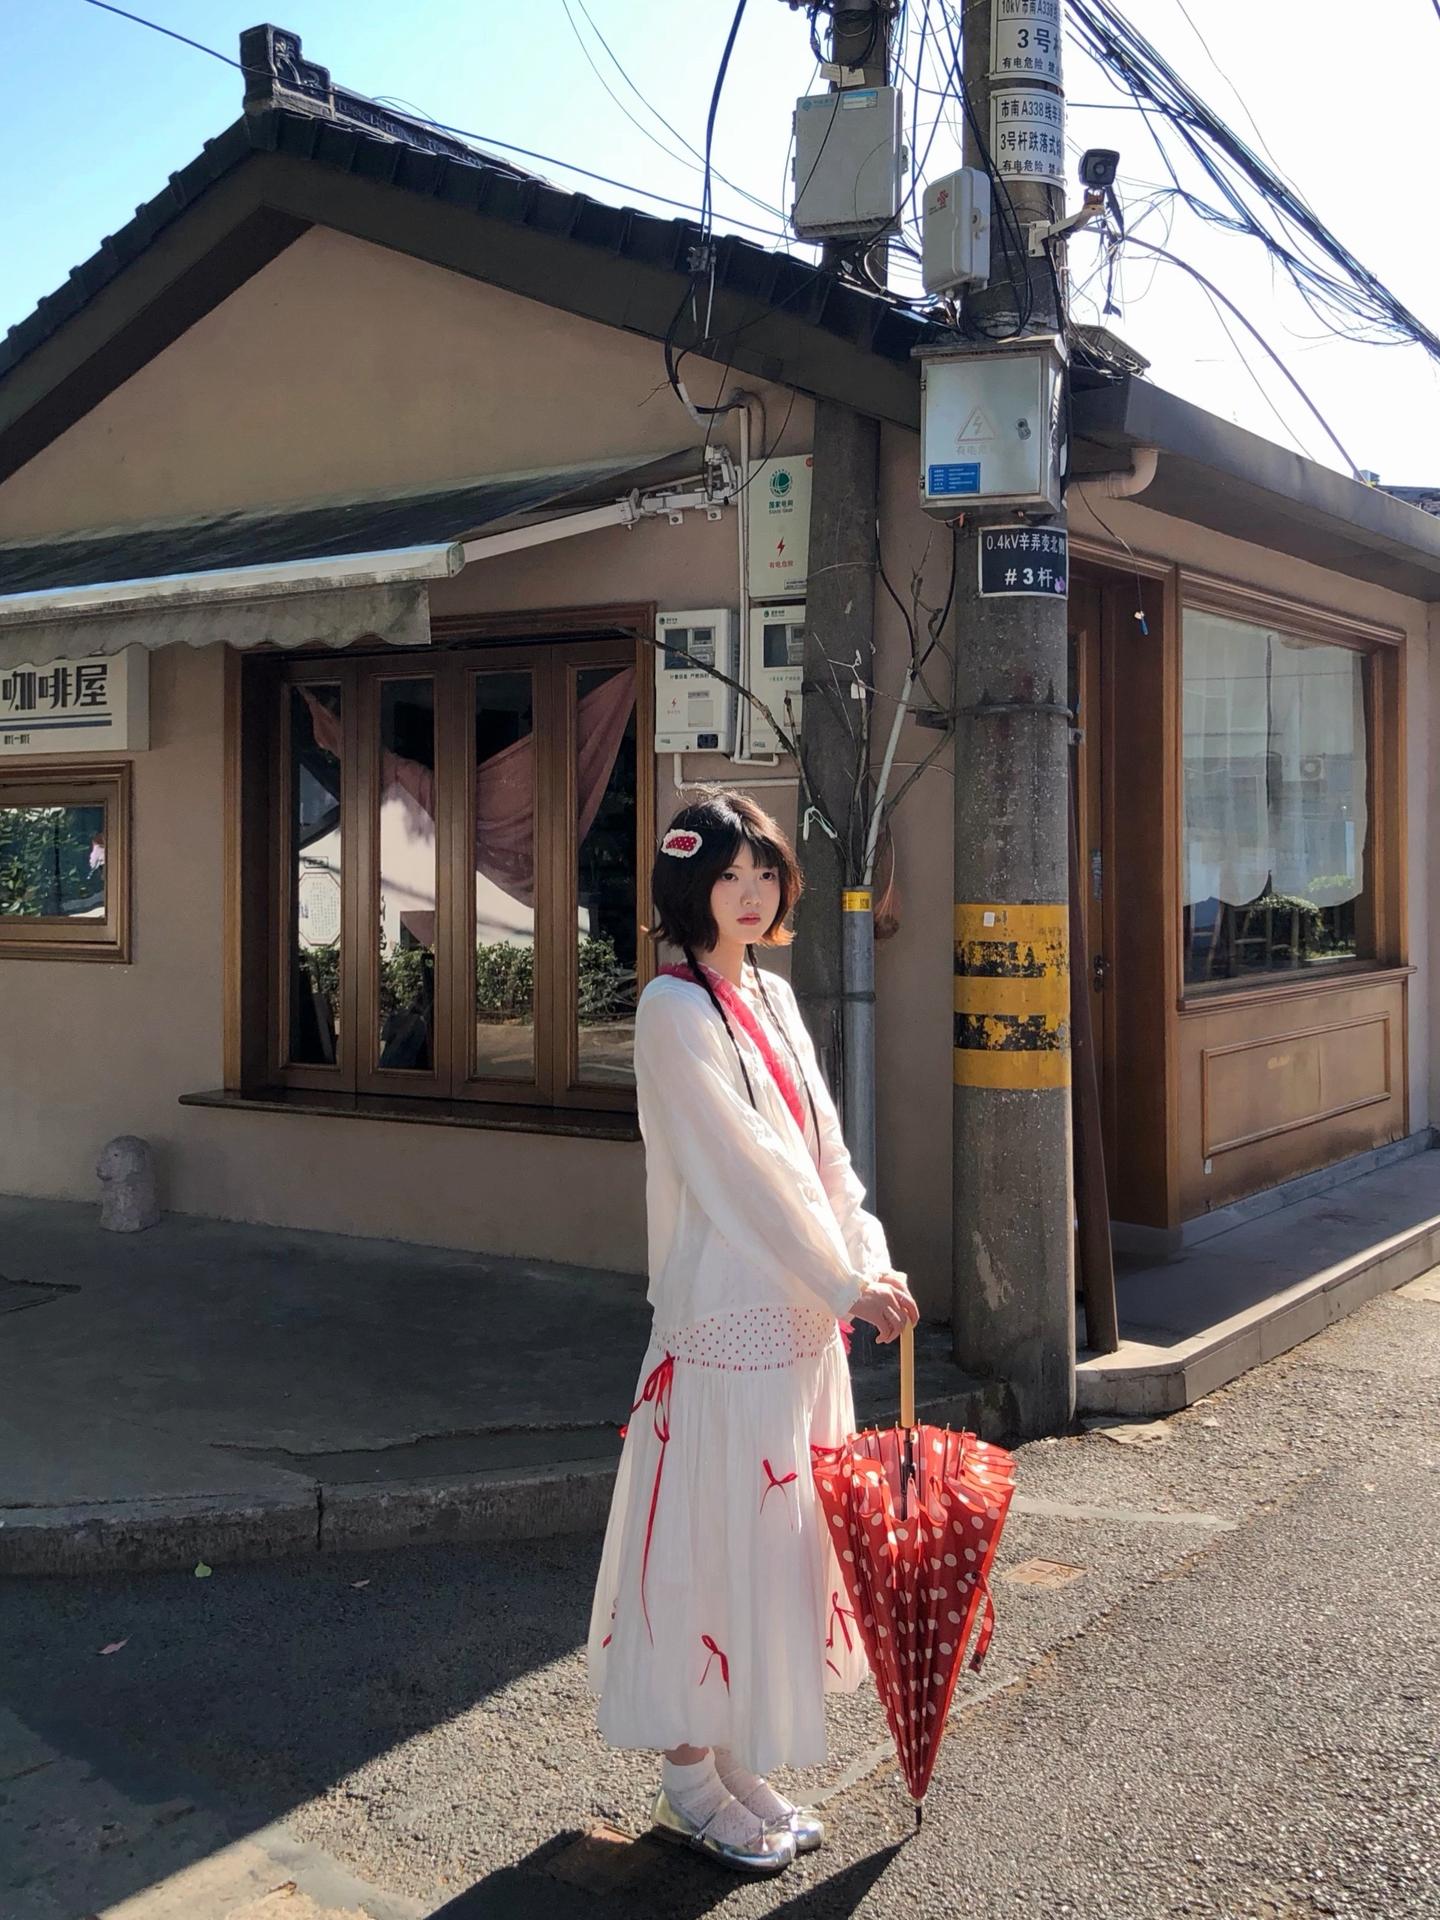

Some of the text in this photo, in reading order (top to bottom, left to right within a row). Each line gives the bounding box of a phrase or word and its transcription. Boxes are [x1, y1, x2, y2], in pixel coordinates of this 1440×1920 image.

[1002, 57, 1043, 70] 有电危险
[1003, 160, 1043, 172] 有电危险
[2, 664, 107, 711] 咖啡屋
